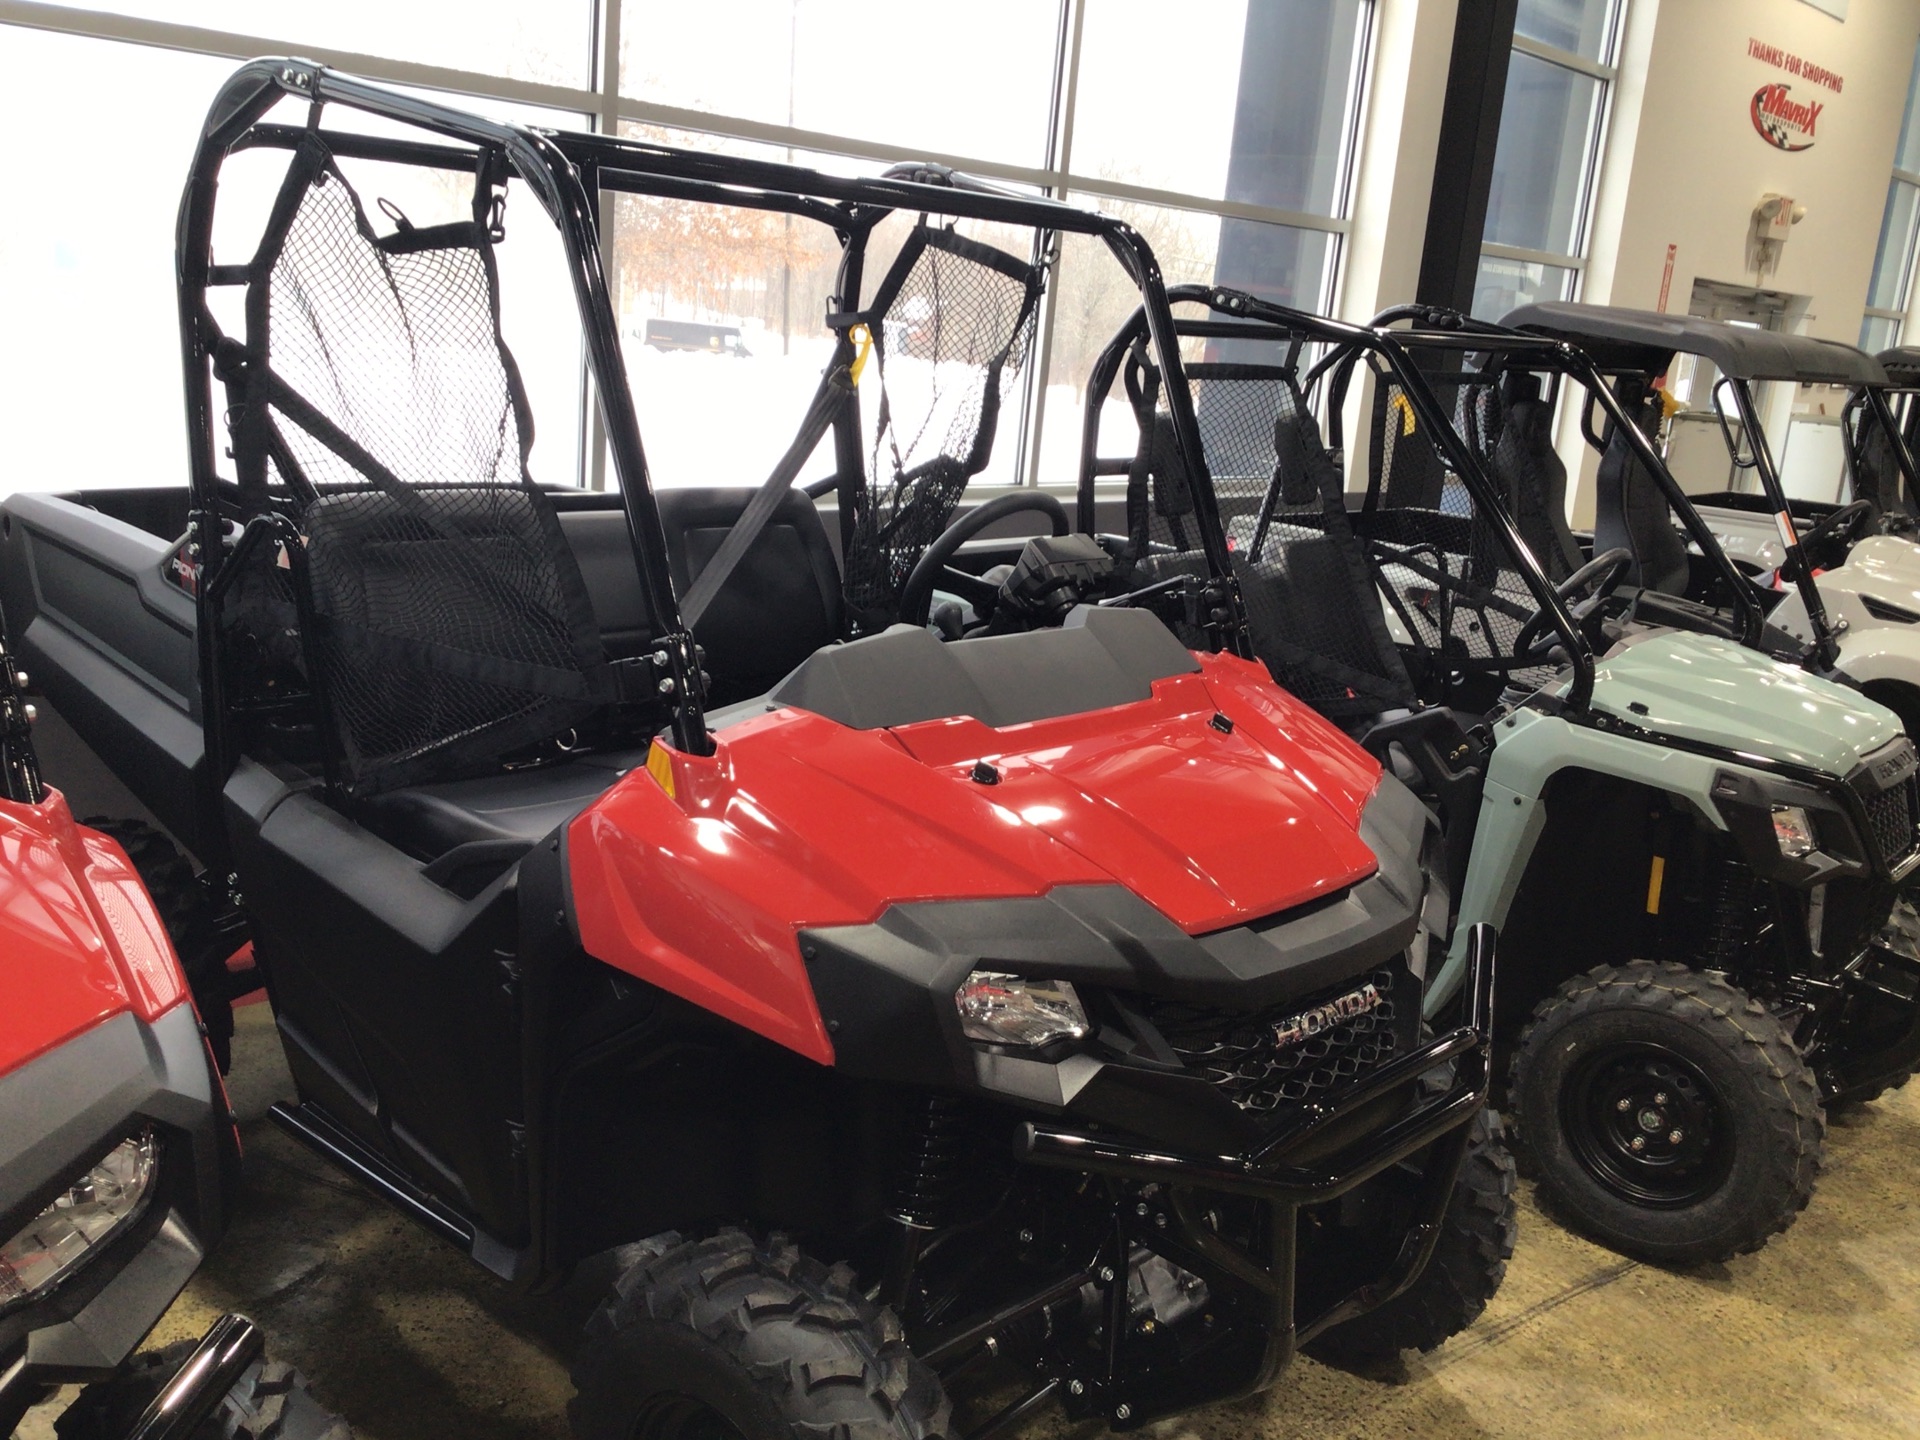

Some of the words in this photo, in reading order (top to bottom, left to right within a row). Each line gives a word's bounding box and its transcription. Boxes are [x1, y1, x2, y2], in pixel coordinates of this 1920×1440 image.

[1747, 37, 1784, 69] THANKS
[1784, 53, 1802, 76] FOR
[1802, 61, 1844, 94] SHOPPING
[172, 557, 197, 582] PION
[1271, 983, 1383, 1049] HONDA
